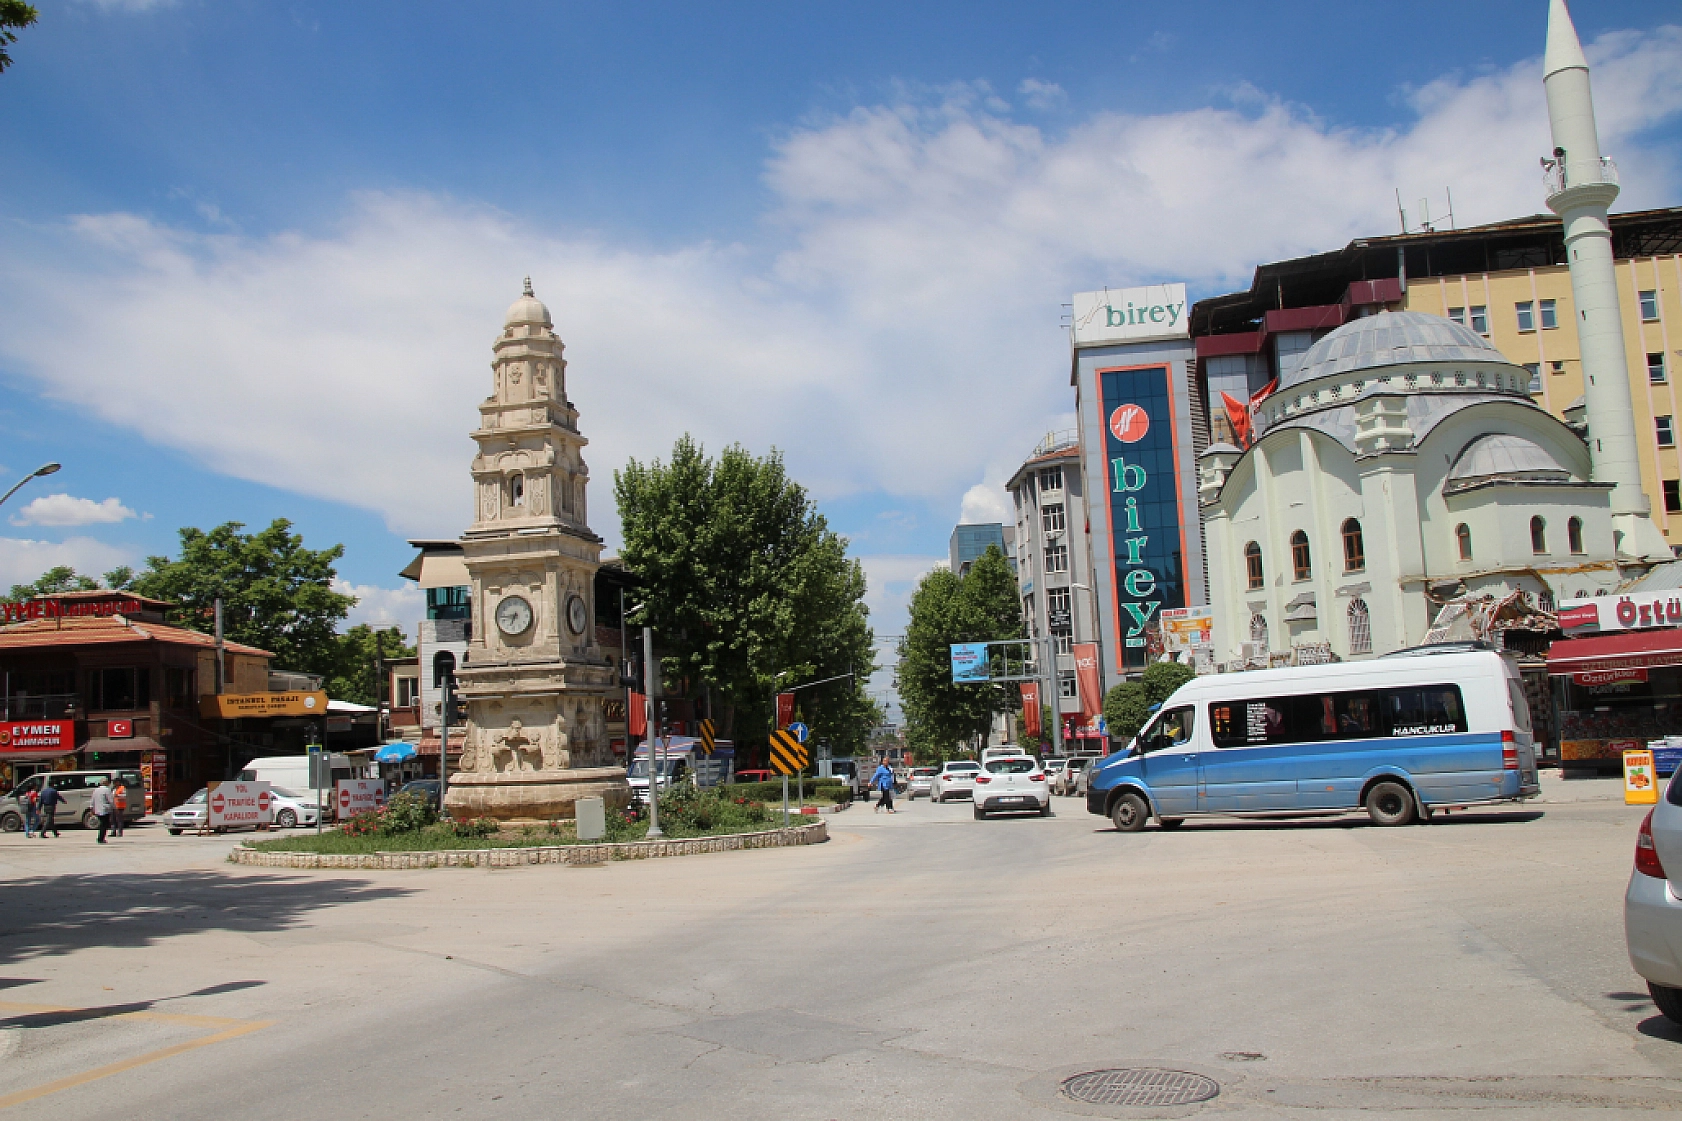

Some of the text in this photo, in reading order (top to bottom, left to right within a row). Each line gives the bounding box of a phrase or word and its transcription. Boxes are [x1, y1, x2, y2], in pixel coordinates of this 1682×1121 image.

[1105, 300, 1184, 328] birey
[1111, 457, 1161, 637] birey
[13, 725, 60, 736] EYMEN
